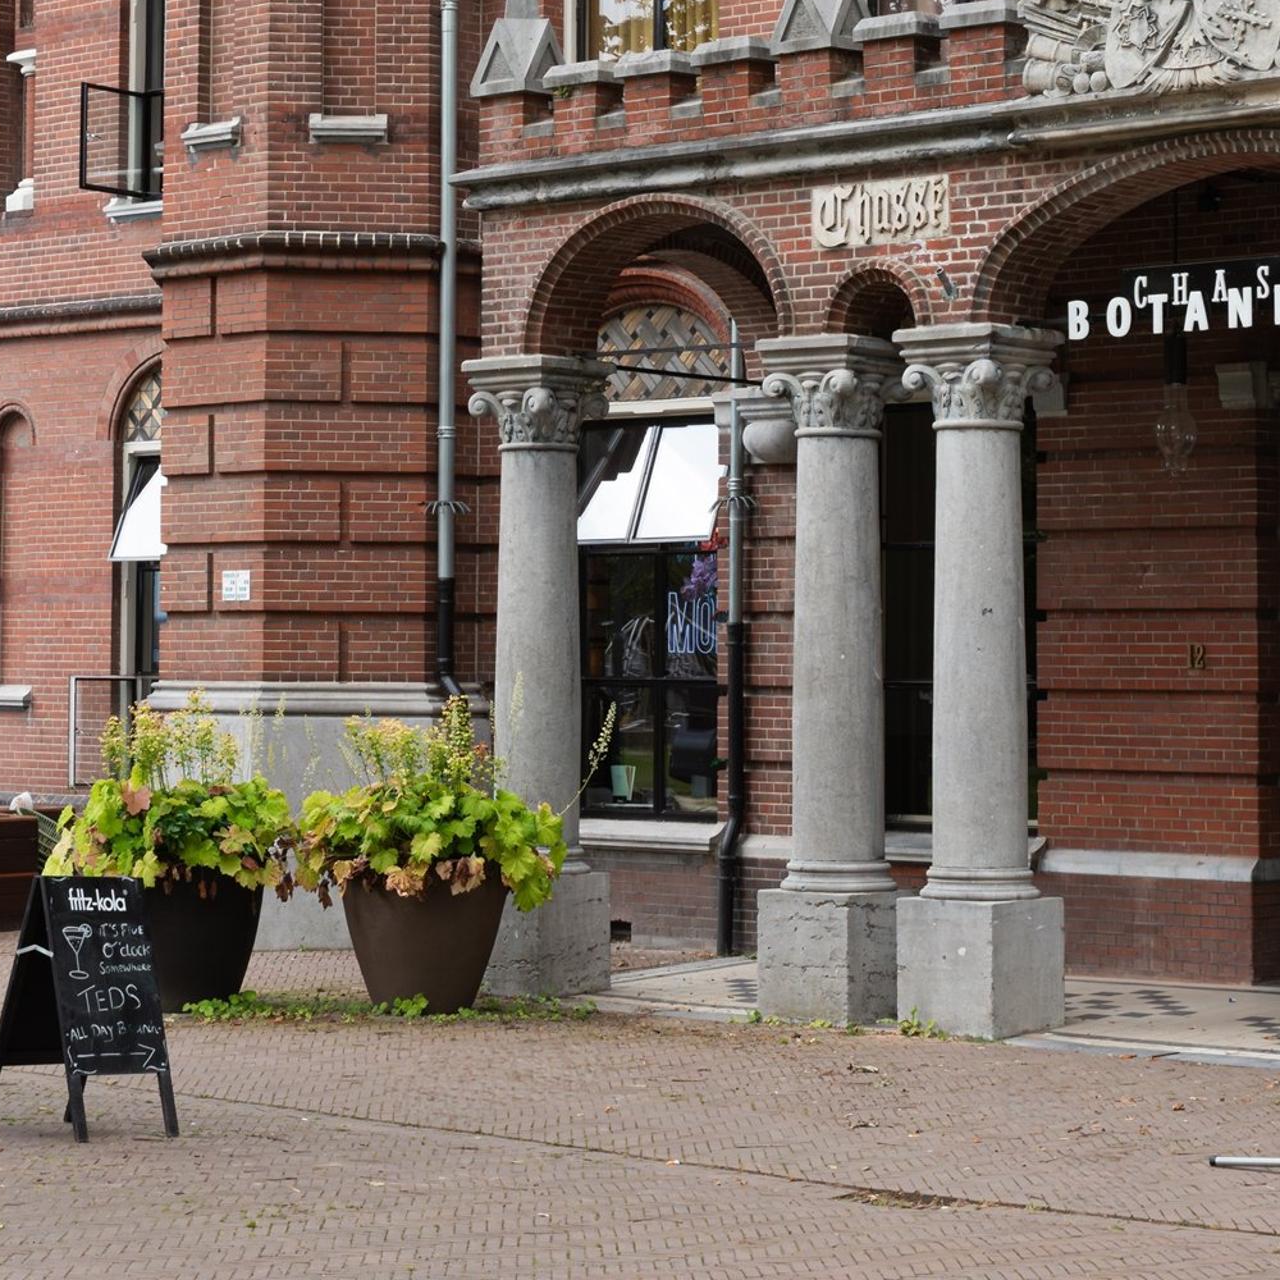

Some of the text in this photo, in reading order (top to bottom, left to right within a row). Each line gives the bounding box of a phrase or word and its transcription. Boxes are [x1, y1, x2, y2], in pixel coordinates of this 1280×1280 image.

[817, 177, 947, 248] Chassé
[667, 591, 718, 655] MO
[68, 887, 127, 912] fritz-kola
[76, 983, 141, 1013] TEDS
